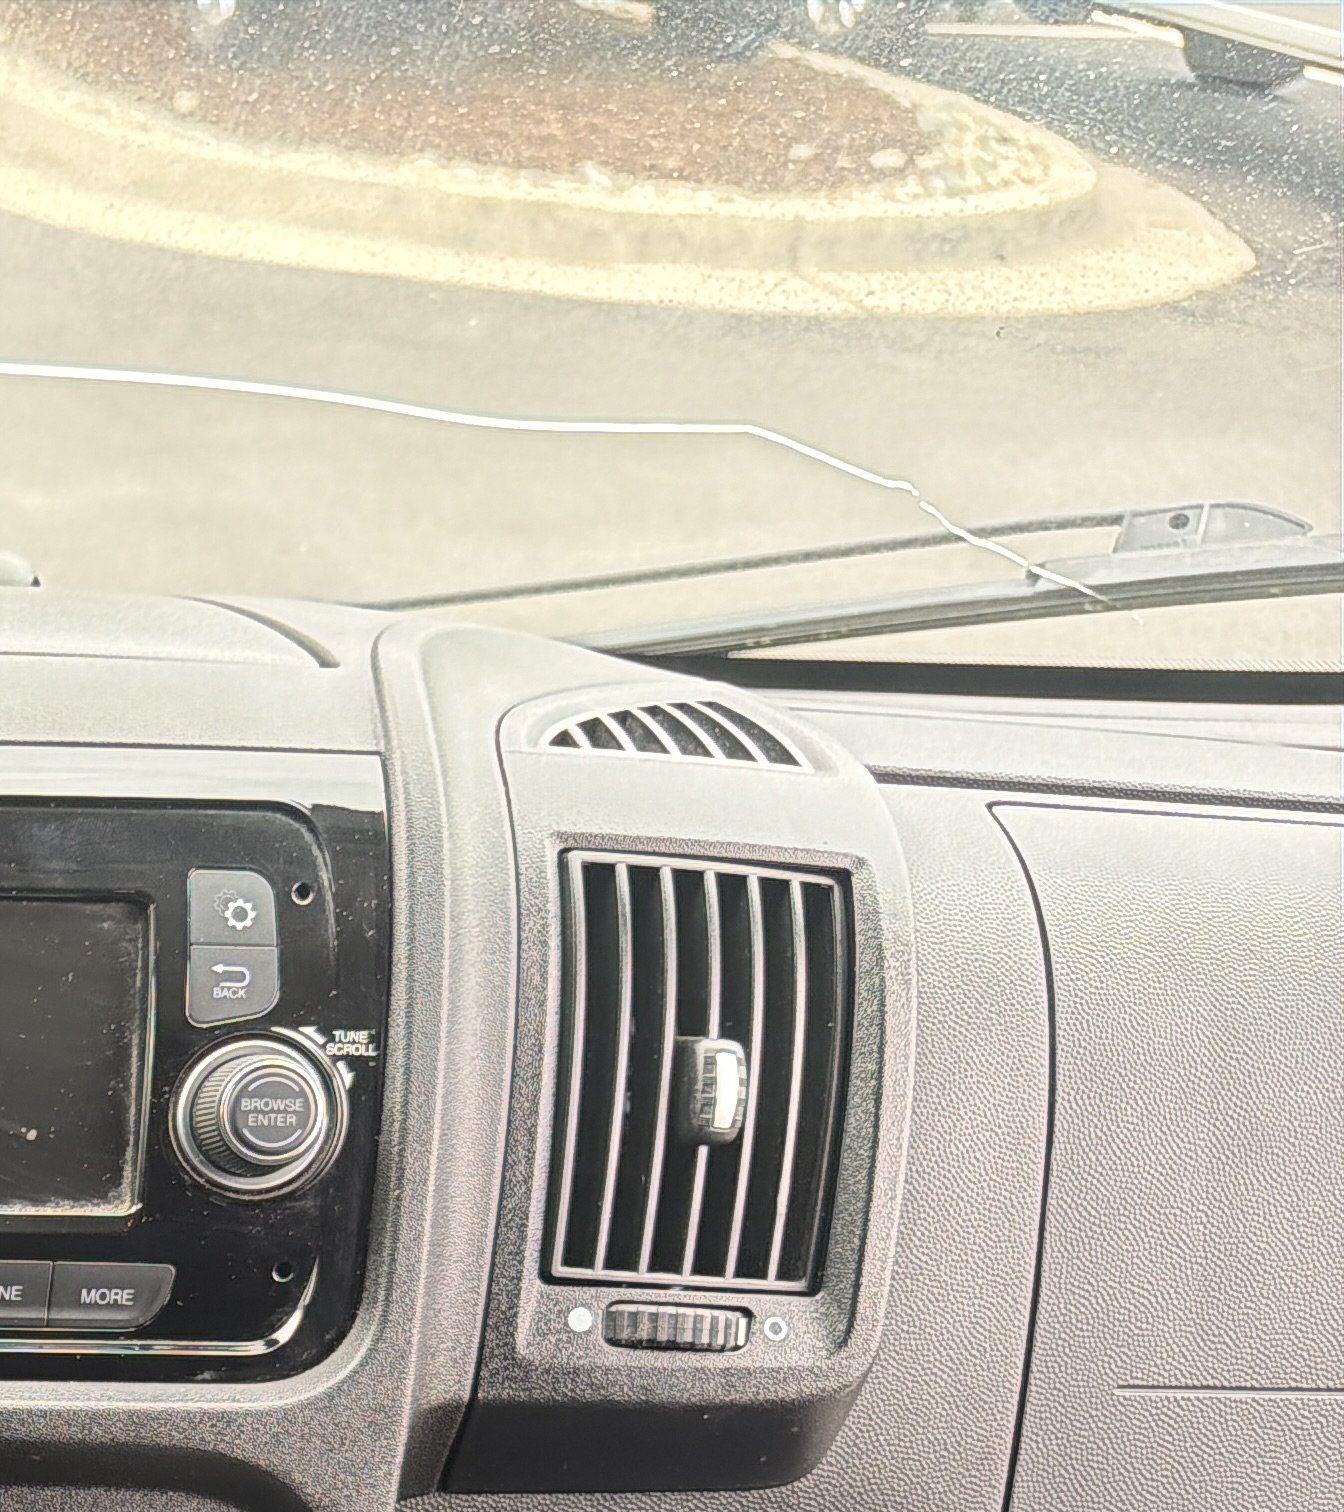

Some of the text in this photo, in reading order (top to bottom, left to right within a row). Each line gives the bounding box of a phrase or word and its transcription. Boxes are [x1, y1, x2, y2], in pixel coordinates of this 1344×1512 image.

[213, 987, 248, 1000] BACK
[332, 1030, 370, 1044] TUNE
[326, 1042, 378, 1057] SCROLL
[241, 1098, 305, 1113] BROWSE
[247, 1113, 297, 1128] ENTER
[80, 1287, 135, 1306] MORE
